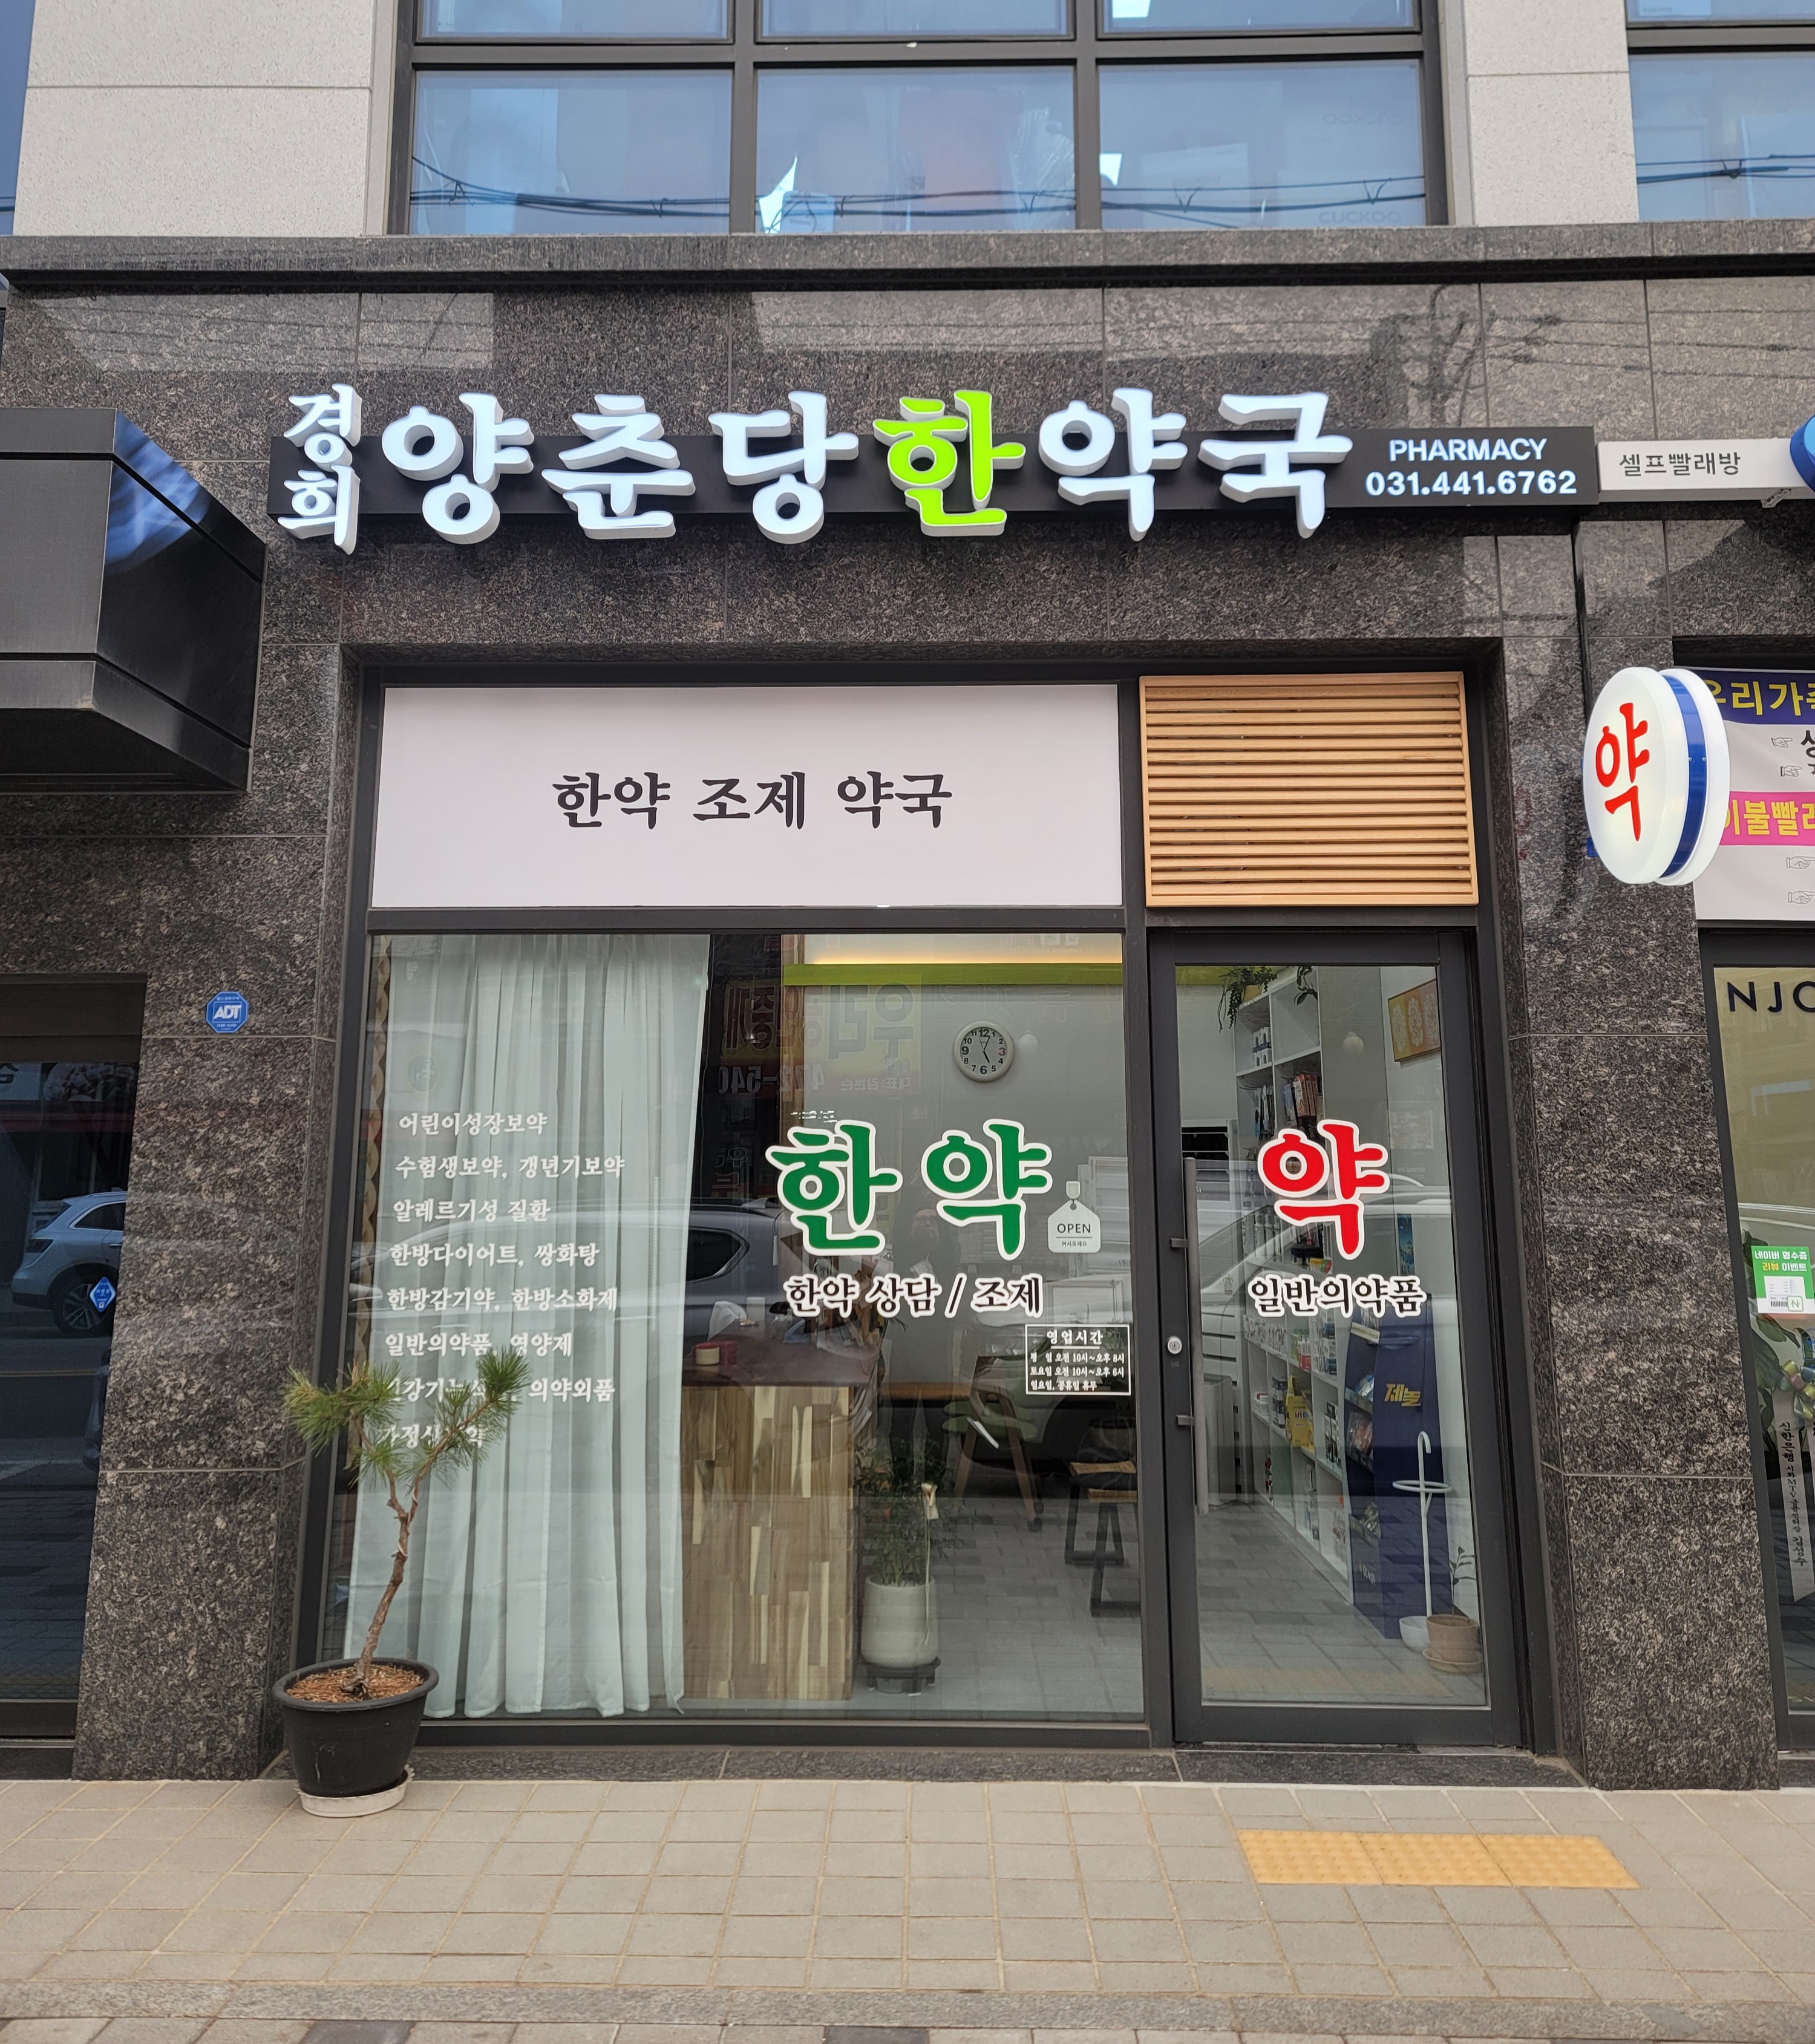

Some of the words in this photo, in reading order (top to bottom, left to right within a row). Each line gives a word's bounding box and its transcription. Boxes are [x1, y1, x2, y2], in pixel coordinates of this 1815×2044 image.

[1319, 210, 1402, 224] CUCKOO
[1390, 438, 1547, 462] PHARMACY
[277, 383, 362, 555] 경희
[1619, 452, 1741, 475] 셀프빨래방
[1365, 470, 1577, 495] 031.441.6762
[1703, 679, 1815, 716] 리가
[1595, 702, 1650, 841] 약
[552, 772, 670, 829] 한약
[693, 771, 805, 830] 조제
[837, 771, 952, 829] 약국
[214, 1005, 241, 1019] ADT
[399, 1112, 548, 1136] 어린이성장보약
[395, 1155, 507, 1180] 수험생보약,
[518, 1155, 626, 1179] 갱년기보약
[1258, 1119, 1390, 1259] 약
[393, 1199, 498, 1223] 알레르기성
[508, 1198, 551, 1222] 질환
[1057, 1223, 1091, 1233] OPEN
[390, 1243, 524, 1268] 한방다이어트,
[534, 1242, 600, 1267] 쌍화탕
[1754, 1250, 1779, 1259] 네이버
[1782, 1251, 1808, 1260] 영수증
[1762, 1262, 1779, 1272] 리뷰
[1782, 1262, 1808, 1272] 이벤트
[387, 1287, 500, 1313] 한방감기약,
[511, 1287, 618, 1312] 한방소화제
[783, 1273, 860, 1318] 한약
[865, 1273, 942, 1319] 상담
[970, 1273, 1044, 1318] 조제
[1248, 1274, 1427, 1317] 일반의약품
[510, 1332, 573, 1357] 영양제
[1046, 1329, 1104, 1345] 영업시간
[1113, 1353, 1125, 1363] 8시
[1030, 1366, 1052, 1377] 토요일
[528, 1377, 615, 1403] 의약외품
[1058, 1380, 1079, 1391] 공휴일
